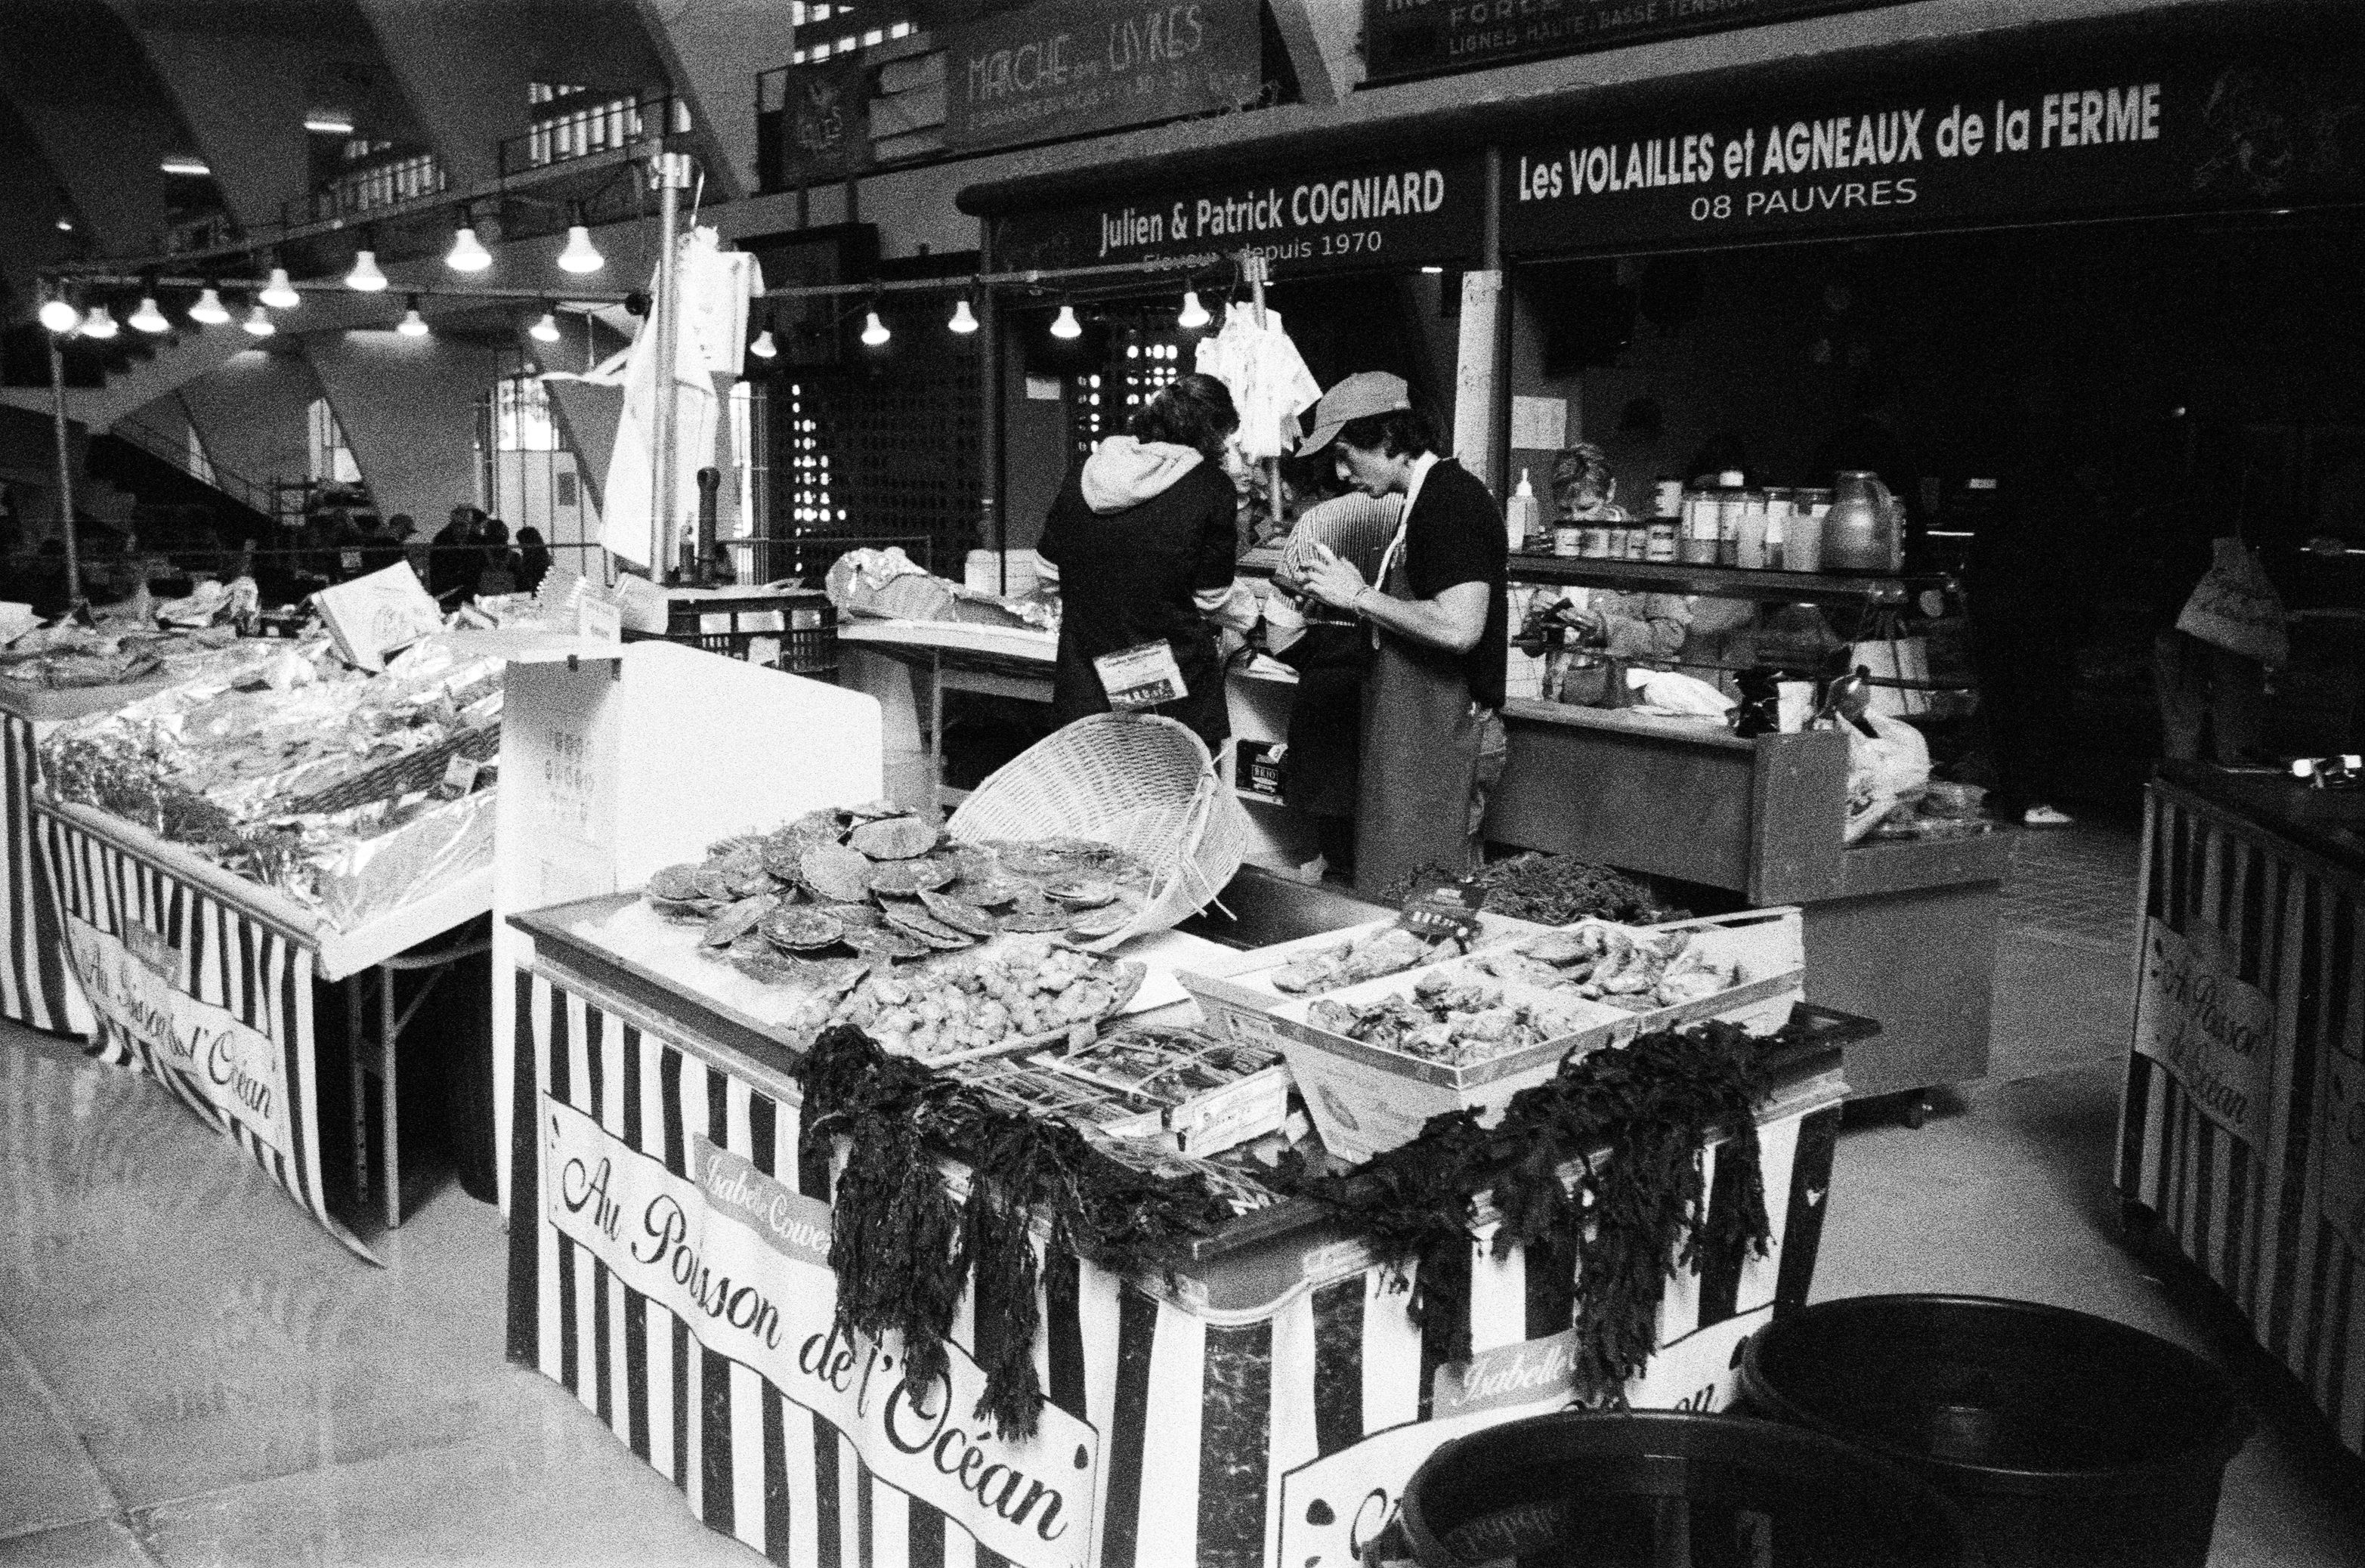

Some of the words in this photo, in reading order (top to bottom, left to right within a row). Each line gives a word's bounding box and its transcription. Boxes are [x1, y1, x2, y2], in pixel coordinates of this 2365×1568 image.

[1448, 28, 1517, 55] LIGNES
[1519, 156, 1563, 201] Les
[1569, 134, 1714, 195] VOLAILLES
[1724, 128, 1754, 179] et
[1762, 110, 1924, 175] AGNEAUX
[1936, 106, 1984, 157] de
[1996, 101, 2030, 153] la
[2042, 85, 2160, 148] FERME
[1099, 210, 1163, 257] Julien
[1171, 202, 1187, 240] &
[1197, 188, 1283, 237] Patrick
[1292, 169, 1444, 226] COGNIARD
[1691, 196, 1731, 221] 08
[1745, 178, 1917, 215] PAUVRES
[1322, 231, 1381, 255] 1970
[562, 1157, 620, 1243] Au
[631, 1193, 782, 1350] Poisson
[799, 1319, 855, 1393] de
